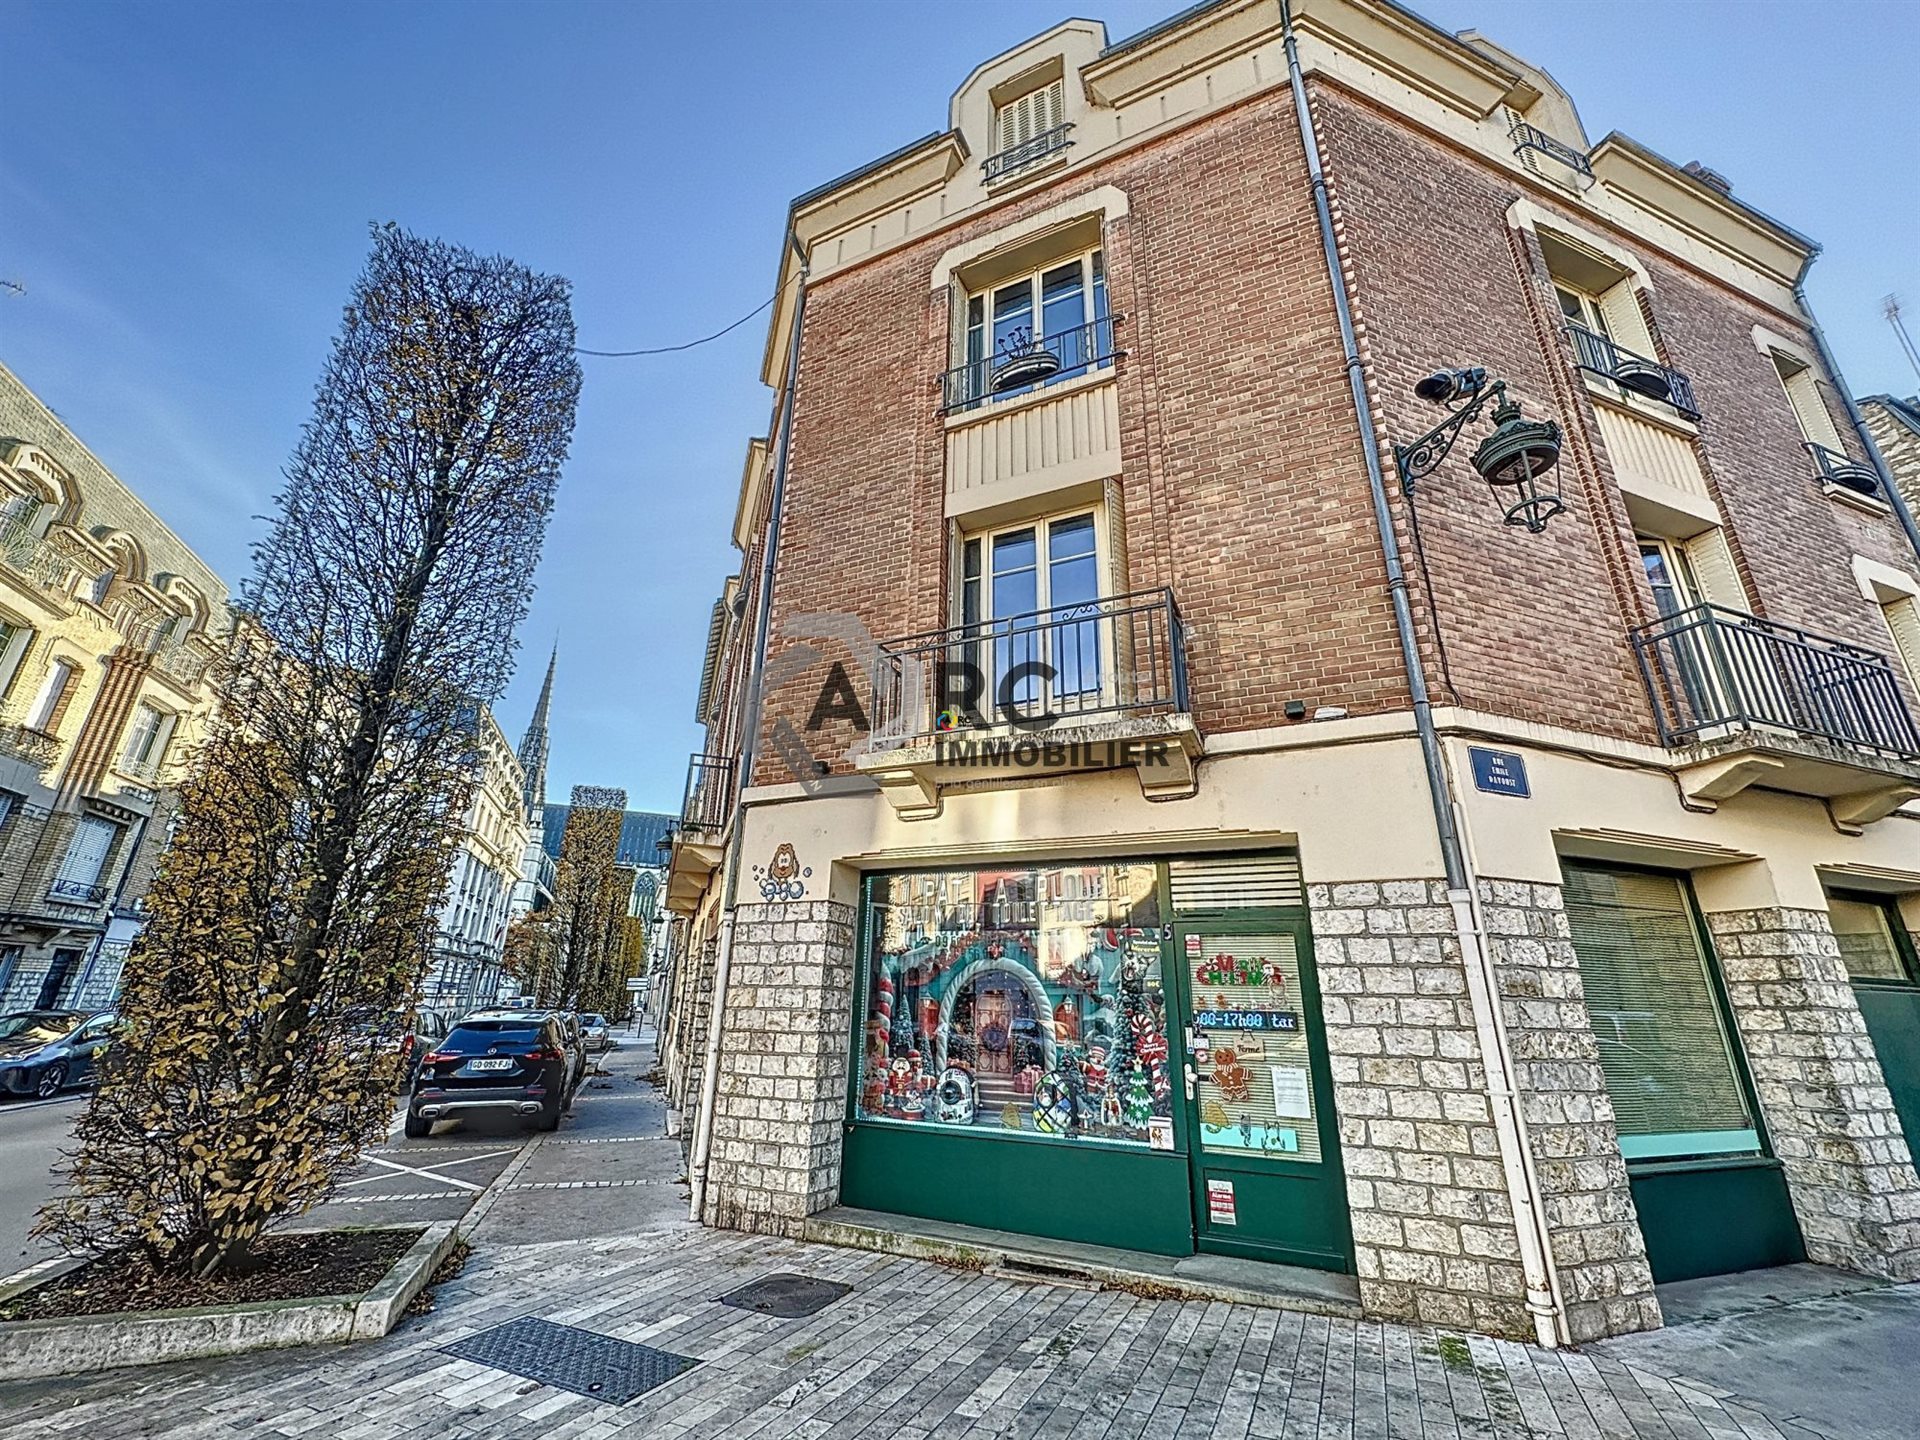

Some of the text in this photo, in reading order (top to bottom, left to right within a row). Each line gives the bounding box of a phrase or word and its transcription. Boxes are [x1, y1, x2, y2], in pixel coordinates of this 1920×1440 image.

[1492, 757, 1504, 766] RUE
[992, 901, 1094, 922] TOILETTAGE
[1164, 923, 1172, 940] 5
[1271, 1013, 1293, 1028] tar
